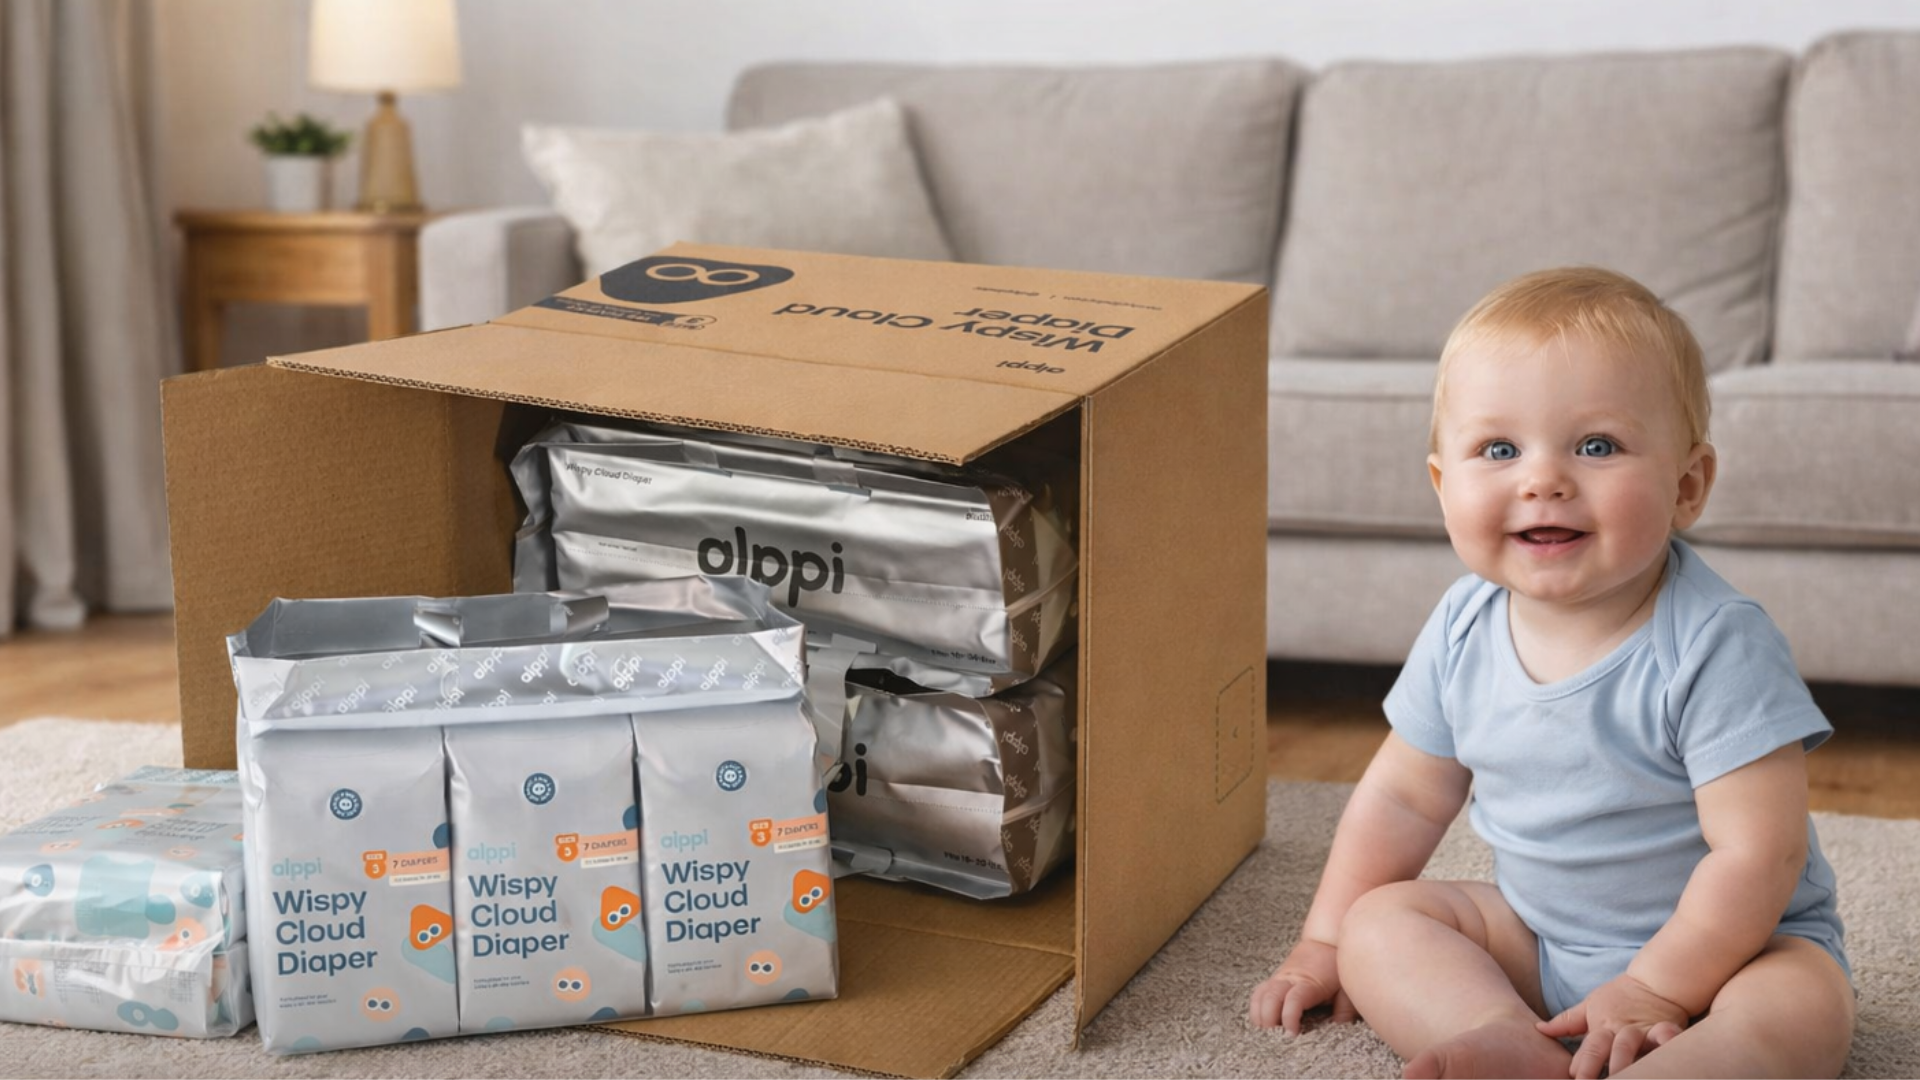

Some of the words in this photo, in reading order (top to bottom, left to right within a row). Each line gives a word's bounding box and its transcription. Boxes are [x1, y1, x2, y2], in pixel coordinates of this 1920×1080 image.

[772, 303, 934, 329] Cloud
[953, 308, 1135, 339] Diaper
[939, 320, 1105, 353] Wispy
[996, 360, 1066, 374] alppi
[698, 526, 844, 608] alppi
[473, 647, 504, 680] alpp
[660, 829, 708, 853] alppi
[778, 828, 783, 836] 7
[467, 842, 516, 864] alppi
[584, 843, 589, 851] 7
[272, 857, 322, 881] alppi
[392, 860, 398, 869] 7
[661, 860, 750, 885] Wispy
[468, 873, 558, 899] Wispy
[664, 883, 748, 913] Cloud
[272, 889, 367, 915] Wispy
[471, 899, 557, 928] Cloud
[276, 916, 365, 945] Cloud
[666, 917, 761, 943] Diaper
[472, 932, 569, 959] Diaper
[277, 950, 378, 977] Diaper
